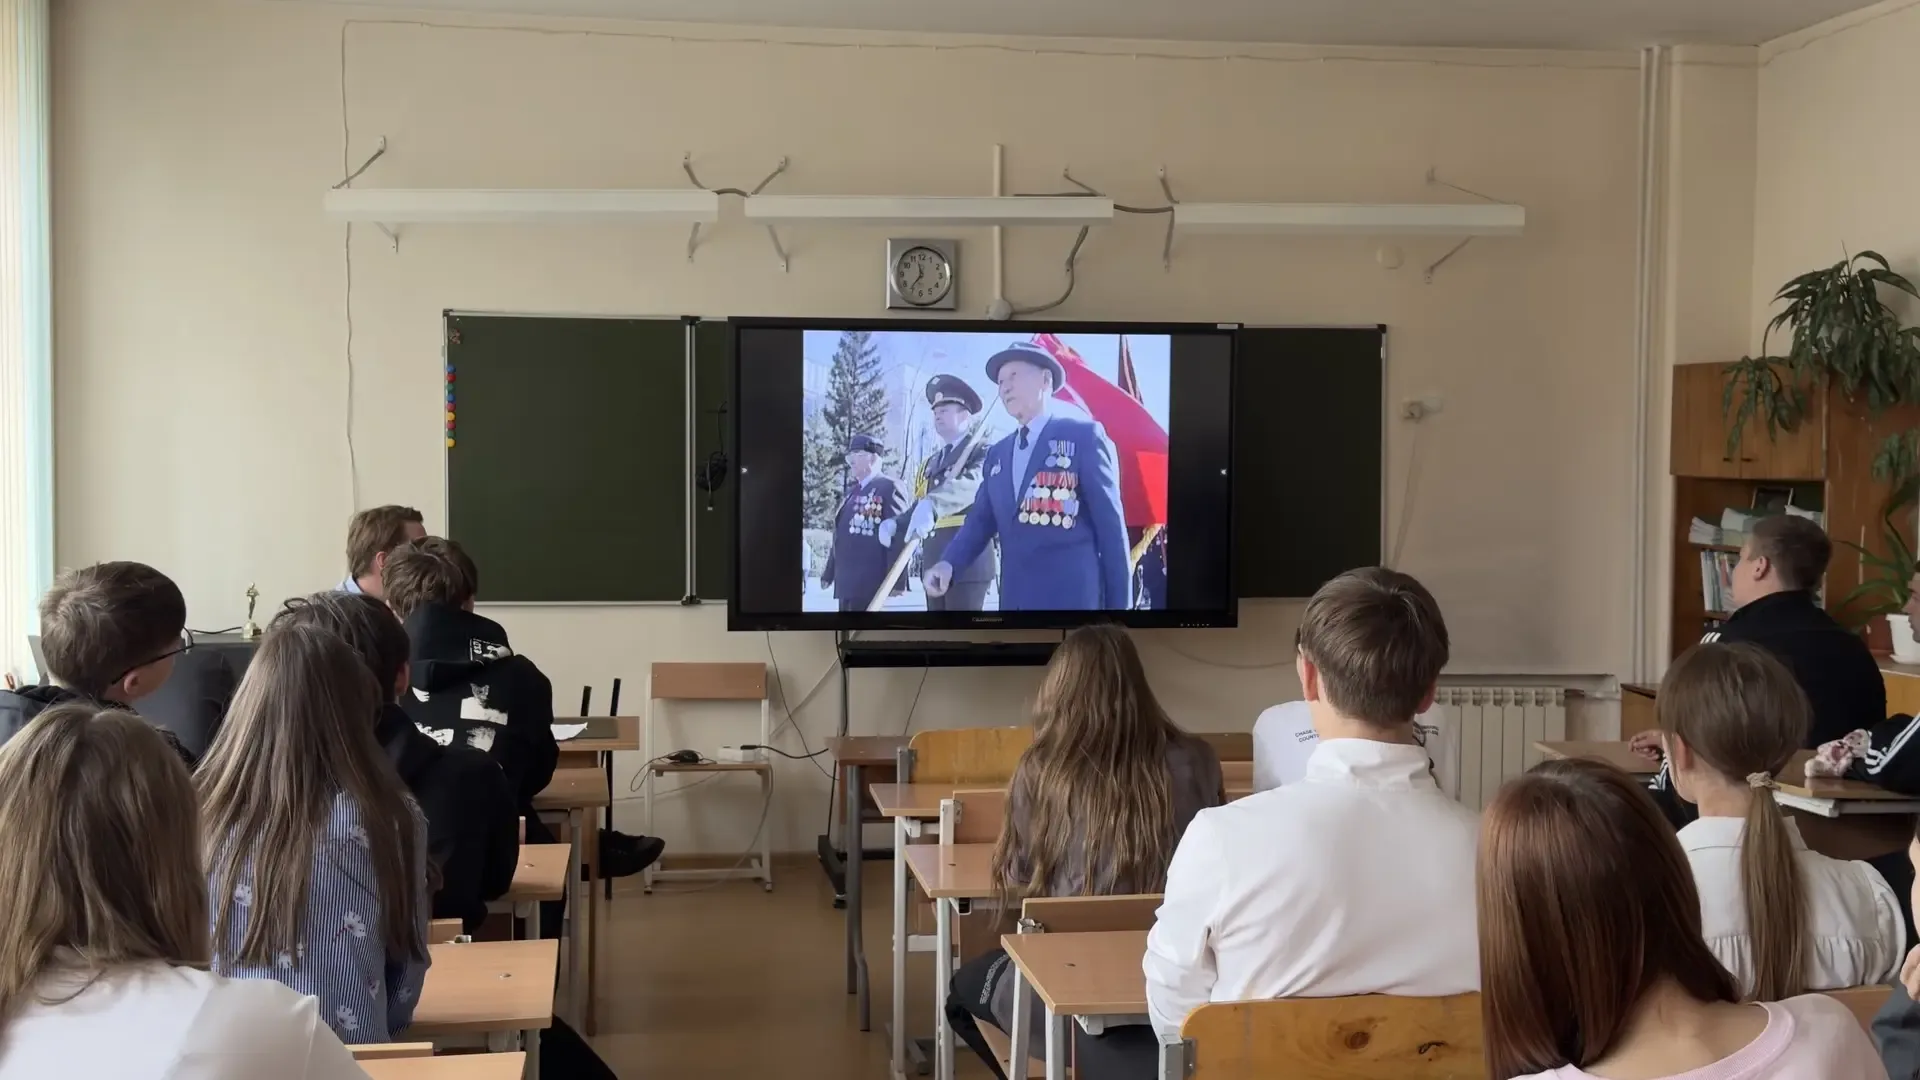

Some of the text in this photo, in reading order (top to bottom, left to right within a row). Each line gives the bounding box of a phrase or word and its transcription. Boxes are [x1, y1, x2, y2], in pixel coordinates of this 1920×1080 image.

[910, 255, 917, 263] 11
[918, 253, 926, 261] 12
[903, 262, 911, 270] 10
[918, 290, 924, 298] 6
